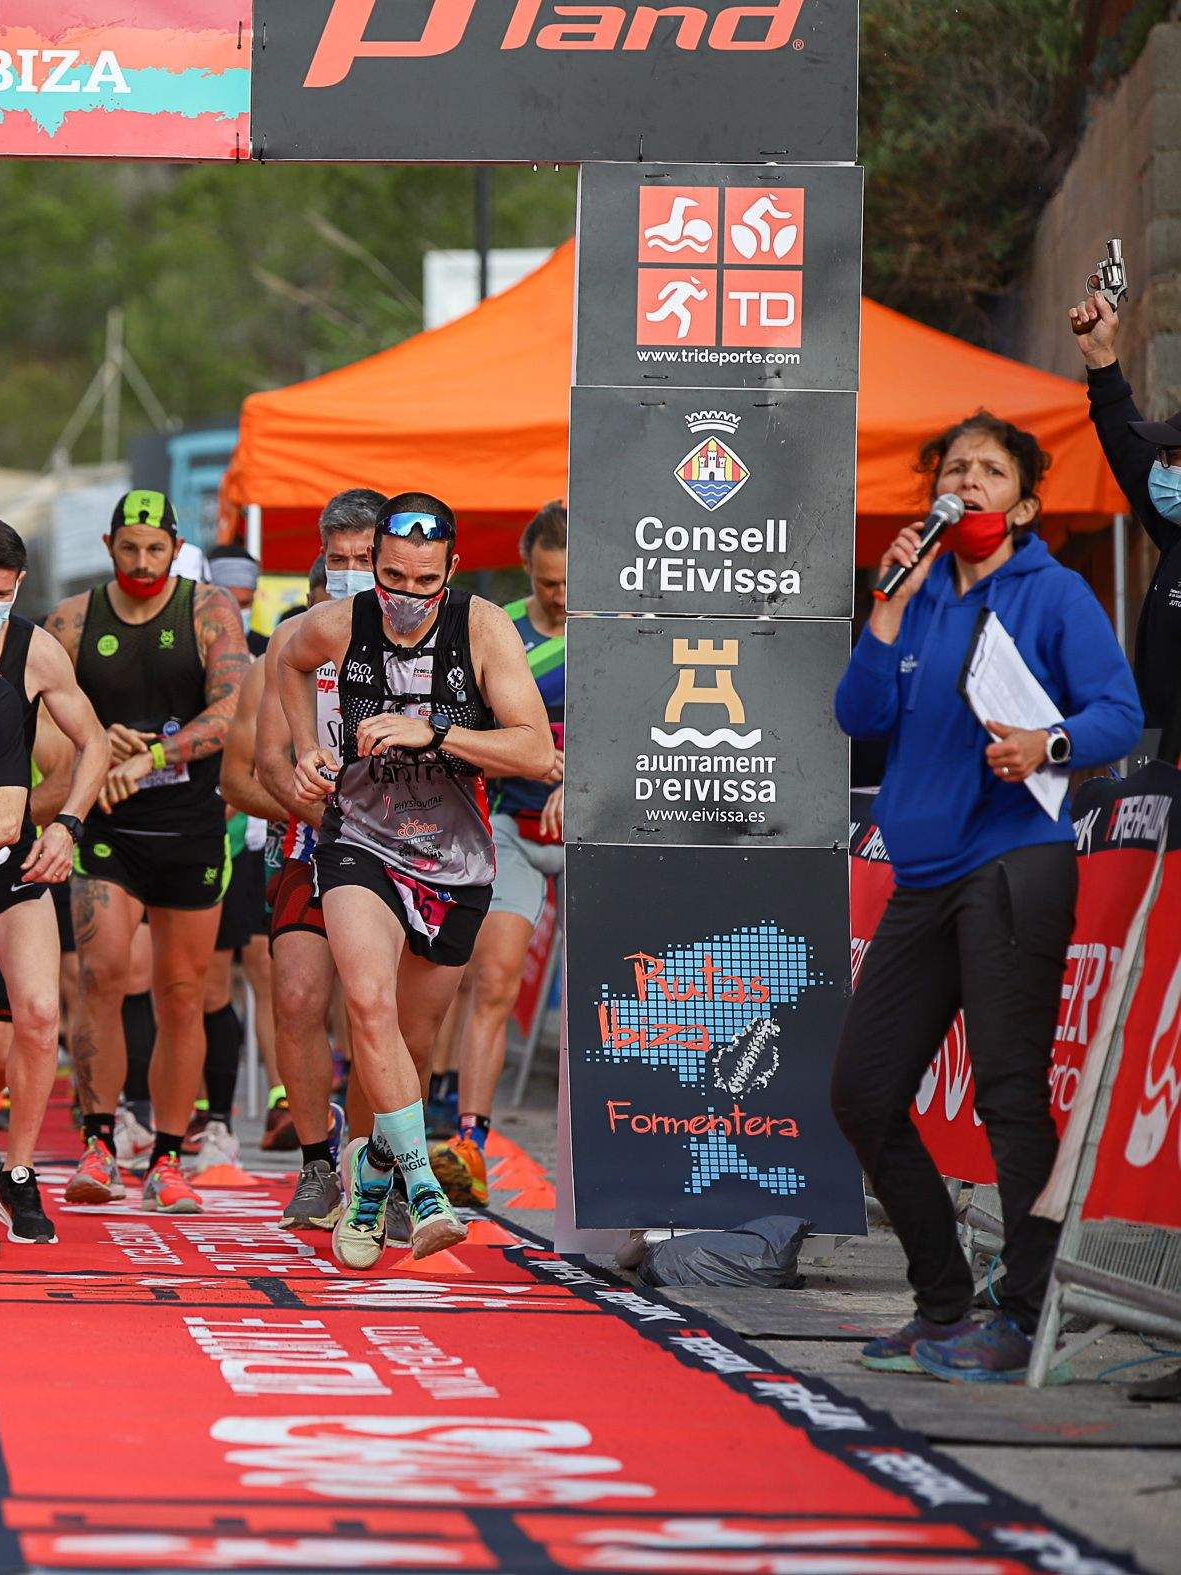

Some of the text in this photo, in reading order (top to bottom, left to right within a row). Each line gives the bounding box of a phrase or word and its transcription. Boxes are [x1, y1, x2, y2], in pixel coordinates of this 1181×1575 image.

[728, 290, 794, 327] TD
[636, 349, 800, 367] www.trideporte.com
[635, 516, 788, 554] Consell
[619, 558, 801, 595] d'Eivissa
[347, 672, 374, 685] MAX
[645, 808, 766, 824] www.eivissa.es
[624, 951, 770, 1004] Rutas
[597, 1001, 715, 1052] Ibiza
[606, 1100, 800, 1138] Formentera
[396, 1149, 419, 1164] STAY
